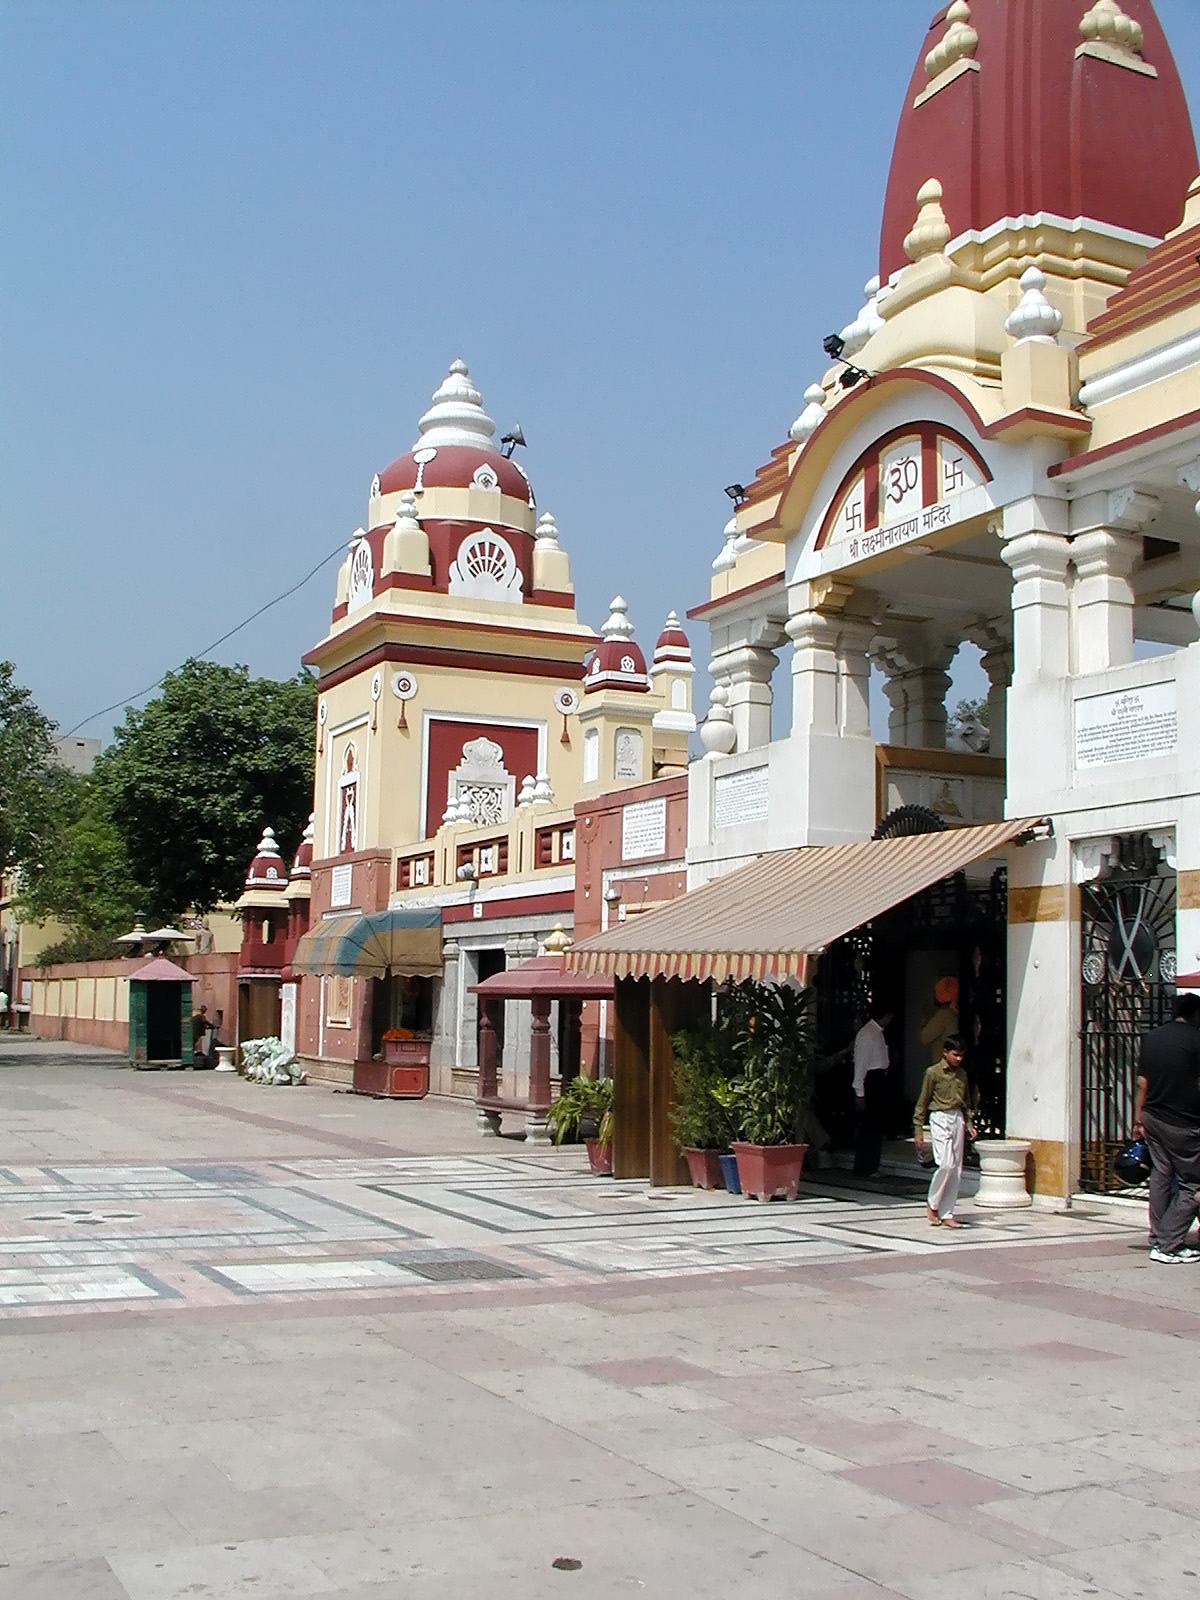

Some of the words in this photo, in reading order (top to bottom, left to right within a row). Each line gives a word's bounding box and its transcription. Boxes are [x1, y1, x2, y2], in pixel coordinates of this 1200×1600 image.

[849, 538, 859, 558] श्री
[862, 517, 919, 555] लक्ष्मीनारायण
[922, 504, 951, 529] मन्दिर
